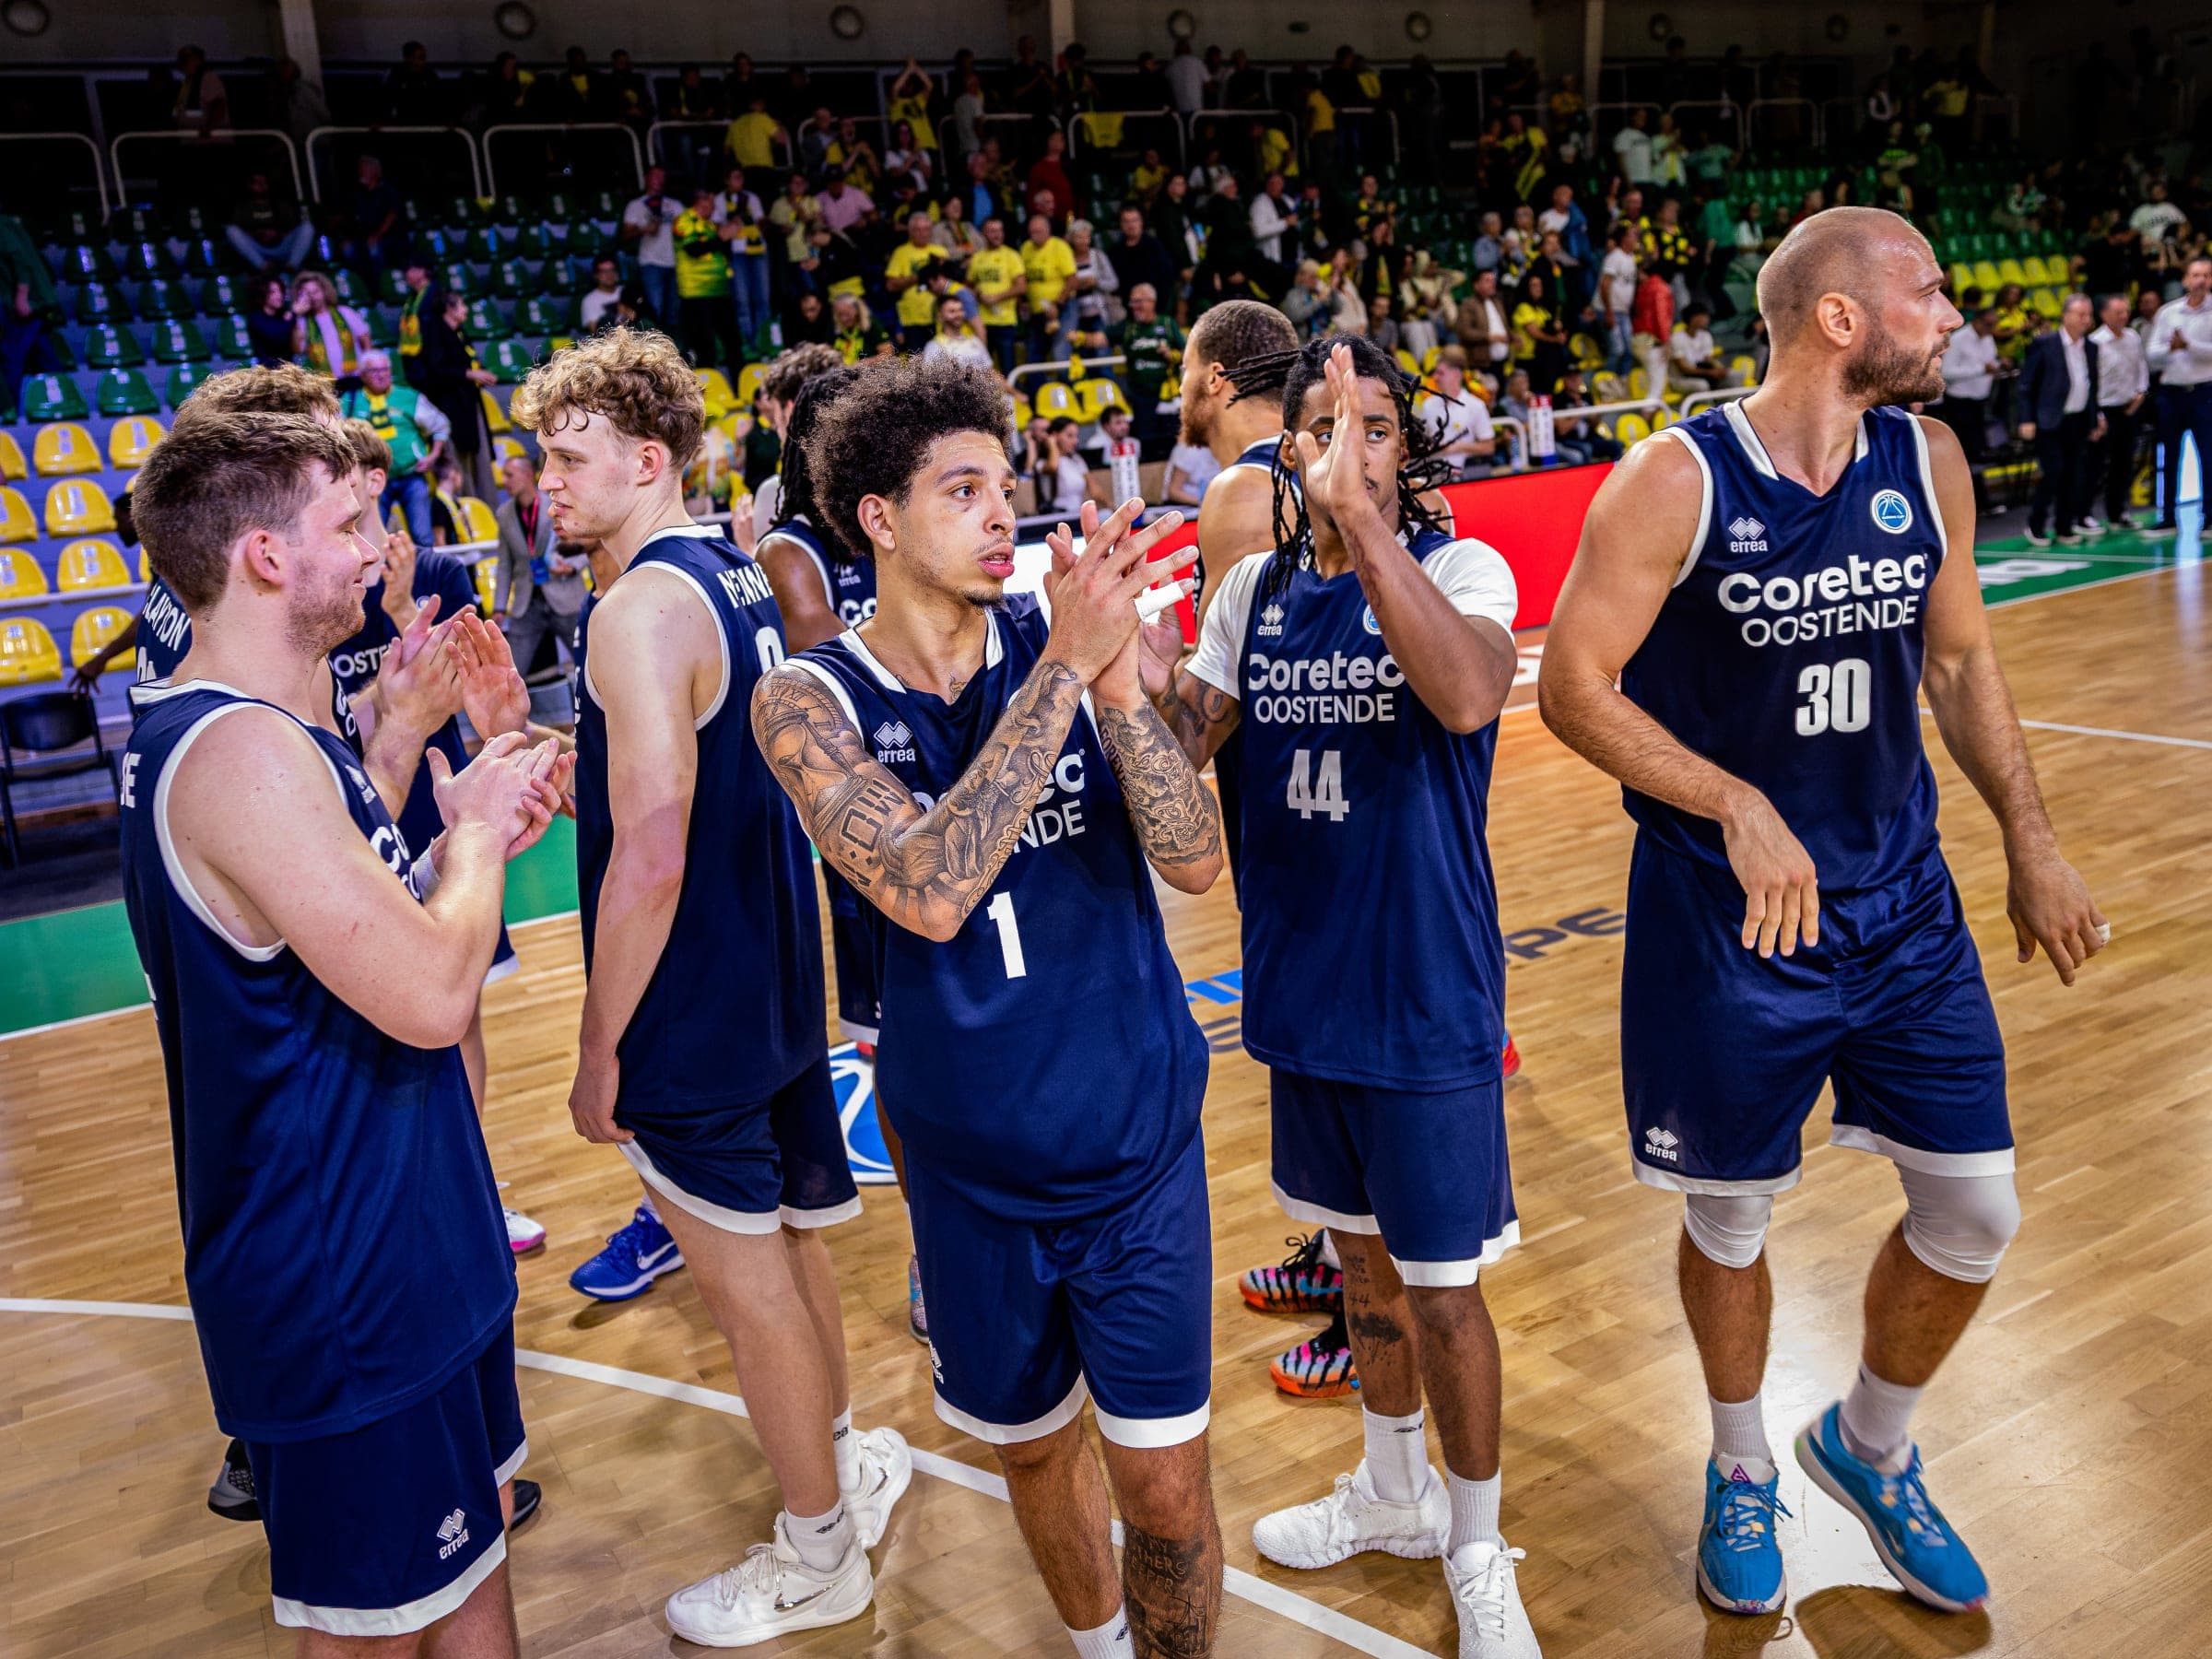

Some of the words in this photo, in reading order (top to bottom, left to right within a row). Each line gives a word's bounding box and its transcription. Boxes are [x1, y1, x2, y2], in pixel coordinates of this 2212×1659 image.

[1730, 539, 1769, 553] errea
[1718, 554, 1926, 614] Coretec
[1257, 624, 1283, 636] errea
[1742, 595, 1920, 647] OOSTENDE
[1248, 650, 1406, 691] Coretec
[1254, 693, 1395, 724] OOSTENDE
[1795, 658, 1872, 736] 30
[877, 748, 916, 763] errea
[1287, 748, 1350, 822] 44
[987, 891, 1027, 980] 1
[1645, 1143, 1677, 1161] errea
[439, 1528, 470, 1559] errea
